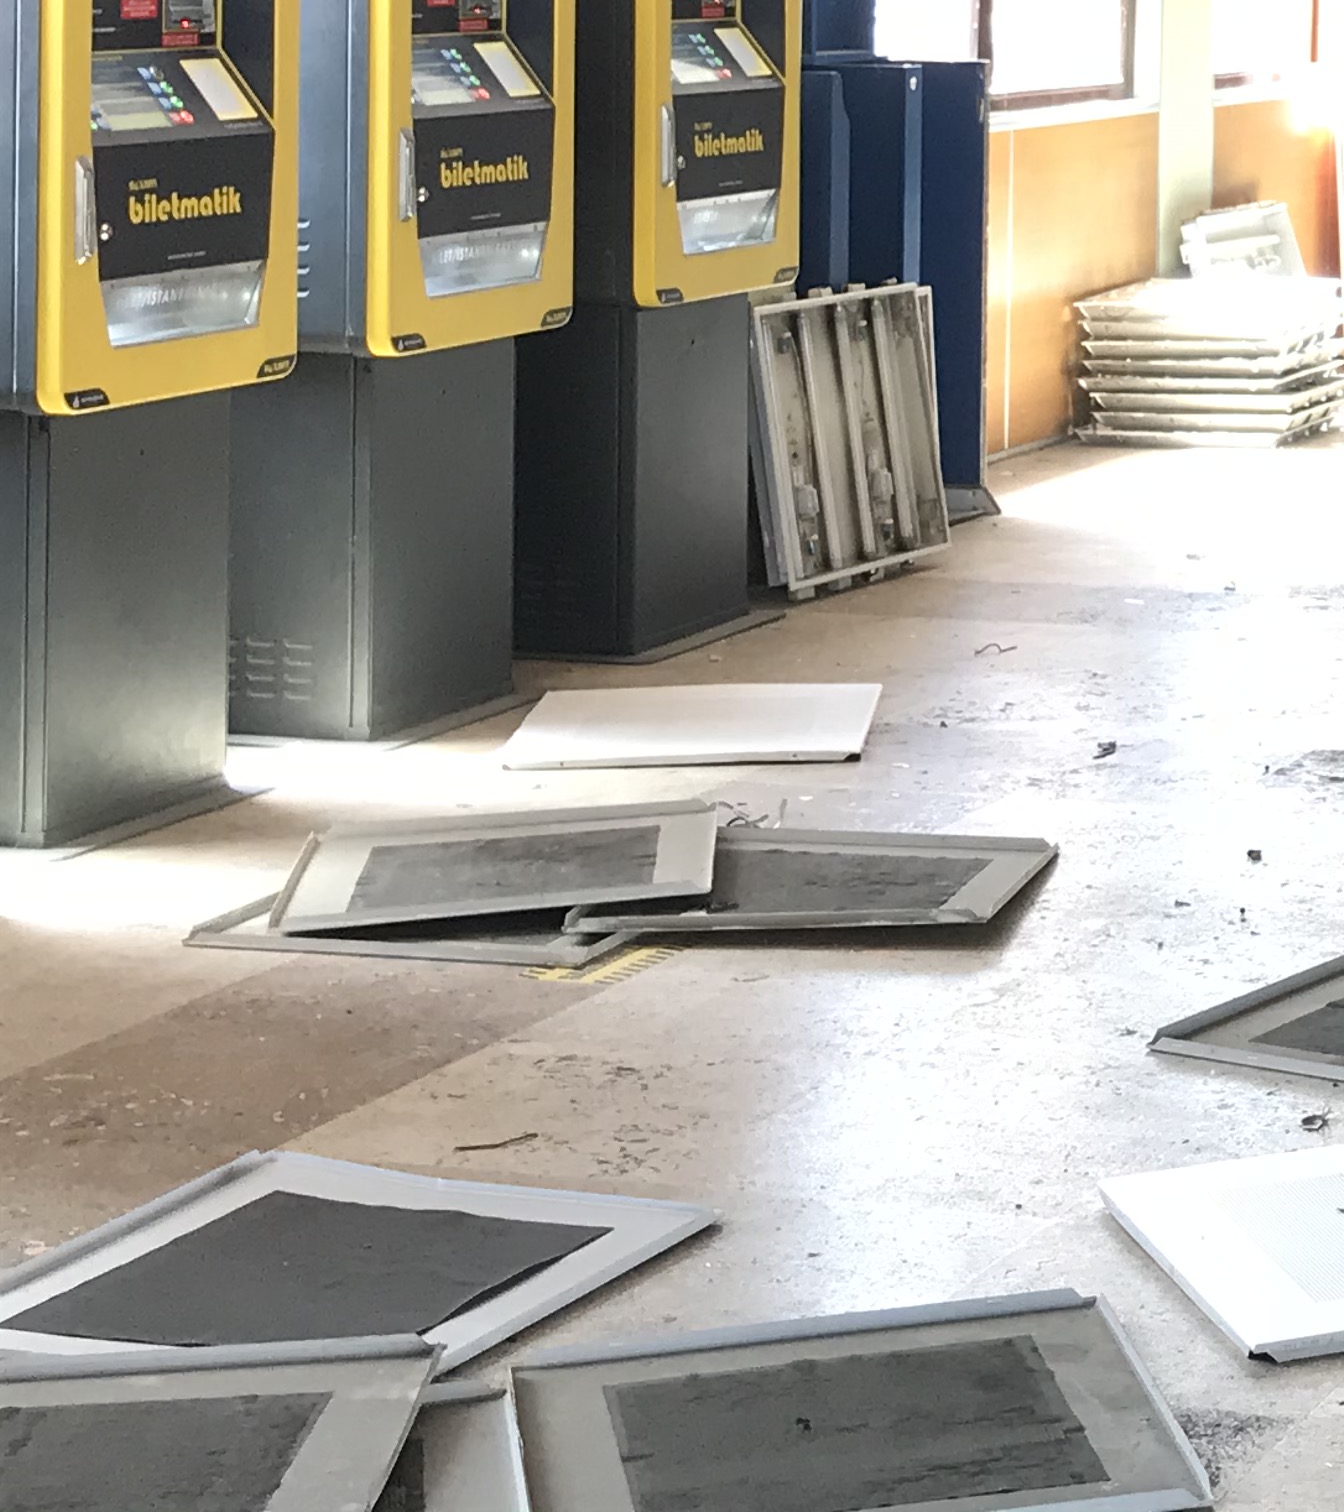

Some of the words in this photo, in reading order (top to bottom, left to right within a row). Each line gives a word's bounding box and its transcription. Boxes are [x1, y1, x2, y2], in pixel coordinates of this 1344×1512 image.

[694, 129, 764, 158] biletmatik
[440, 155, 529, 188] biletmatik
[128, 185, 242, 224] biletmatik
